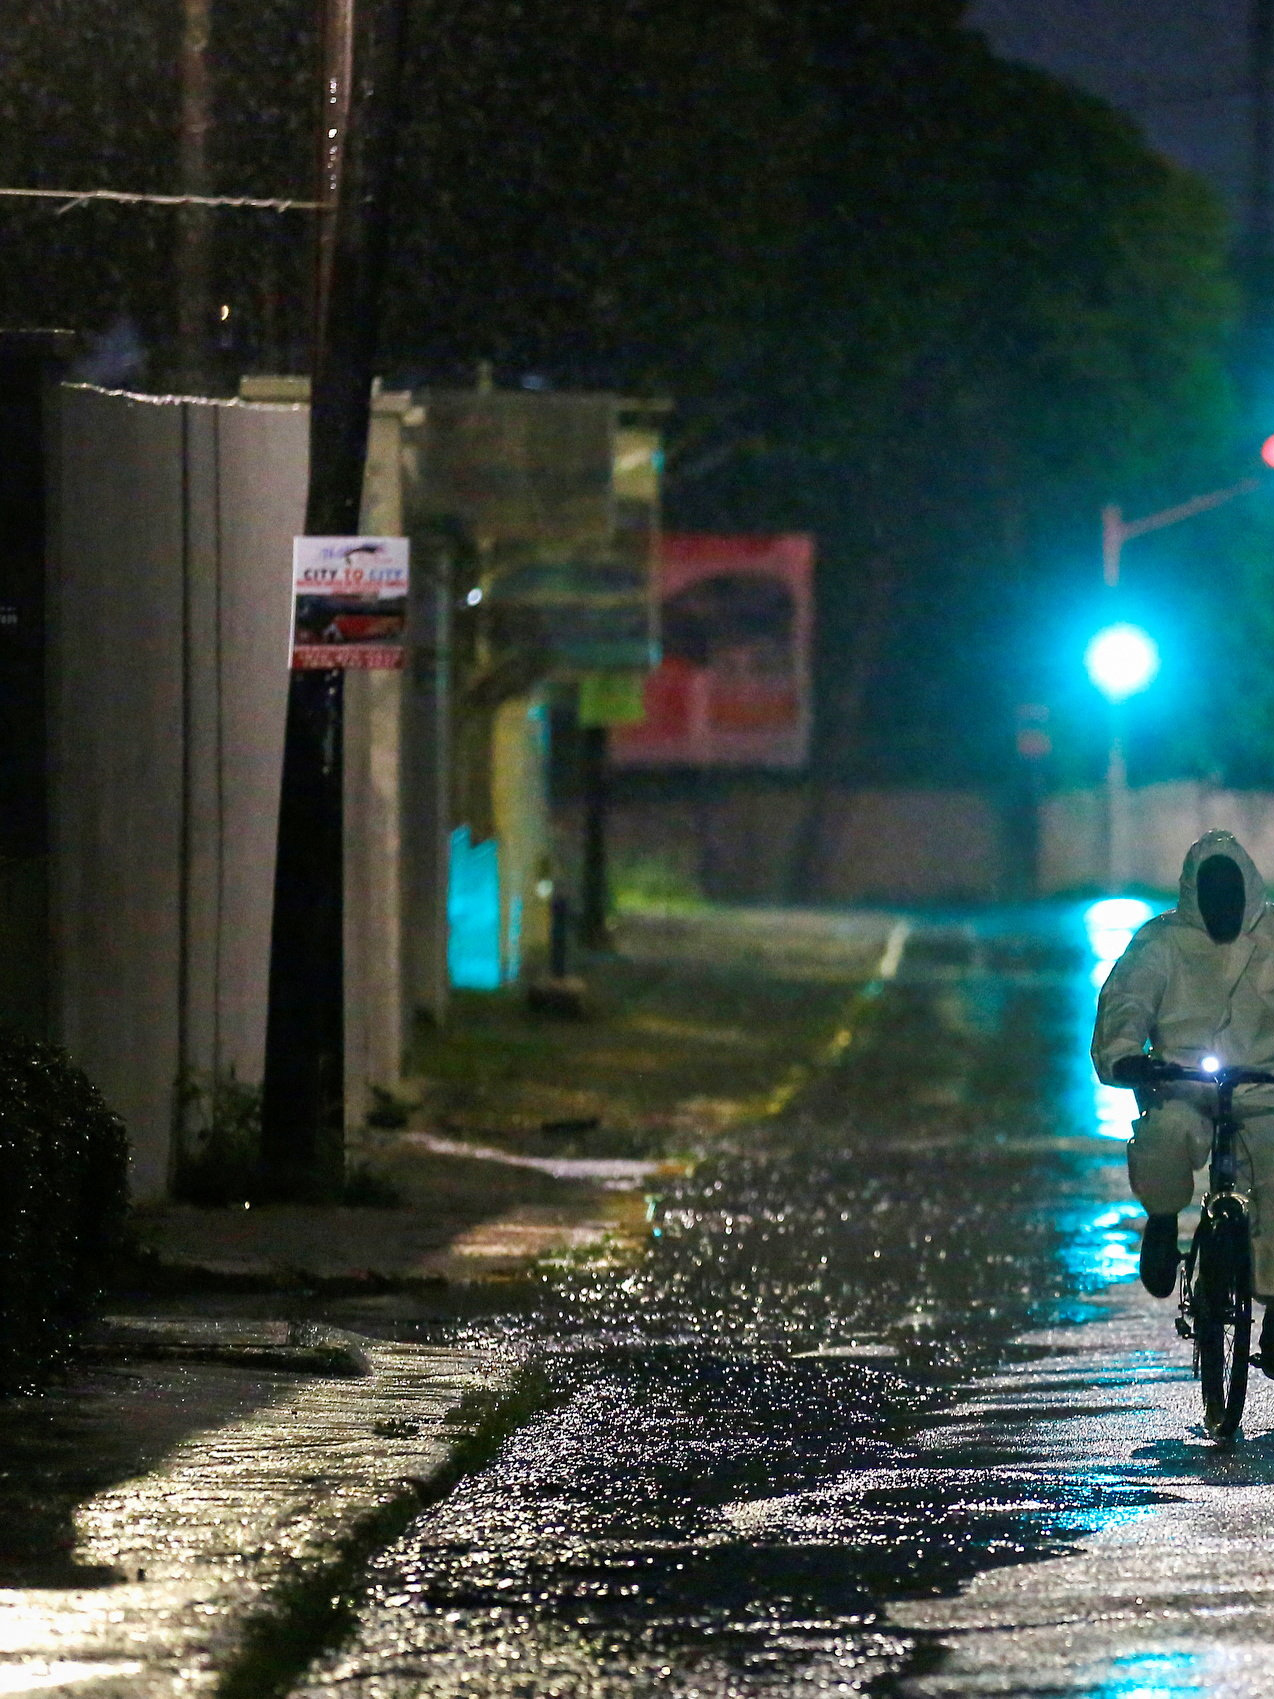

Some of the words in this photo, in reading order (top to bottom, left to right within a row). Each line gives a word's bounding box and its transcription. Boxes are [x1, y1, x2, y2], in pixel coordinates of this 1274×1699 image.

[303, 568, 338, 581] CITY
[343, 568, 365, 581] TO
[368, 568, 403, 581] CITY
